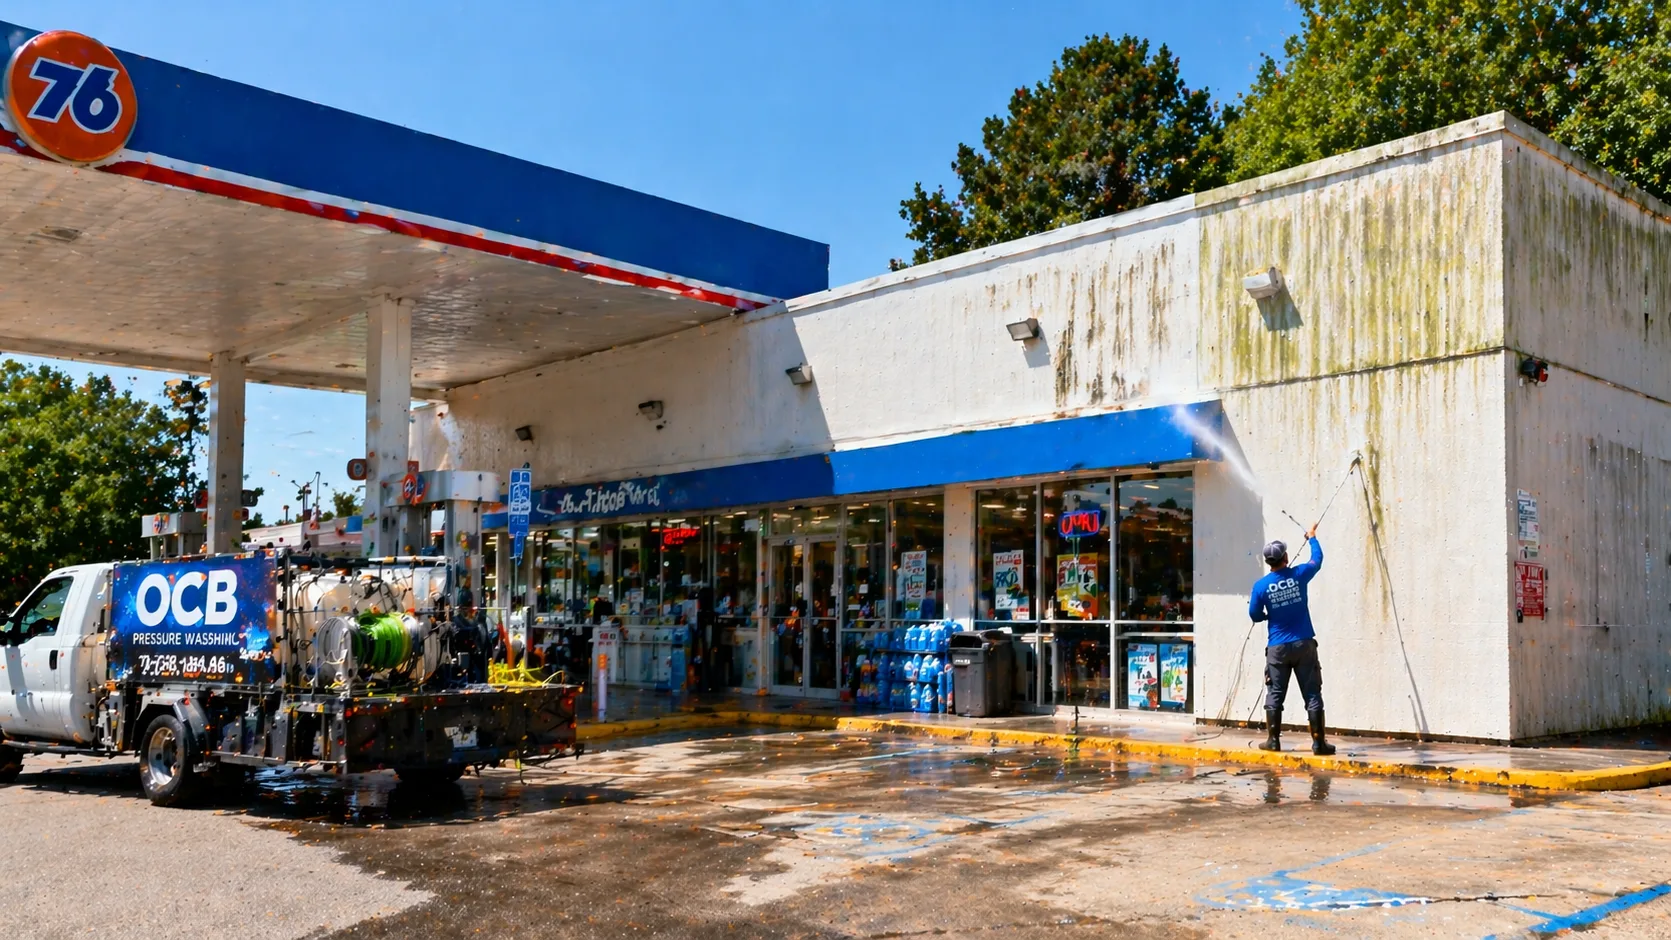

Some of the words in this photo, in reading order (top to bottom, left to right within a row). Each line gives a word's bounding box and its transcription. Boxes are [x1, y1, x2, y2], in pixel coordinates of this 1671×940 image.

[27, 57, 122, 134] 76
[136, 569, 238, 627] OCB
[133, 632, 182, 645] PRESSURE
